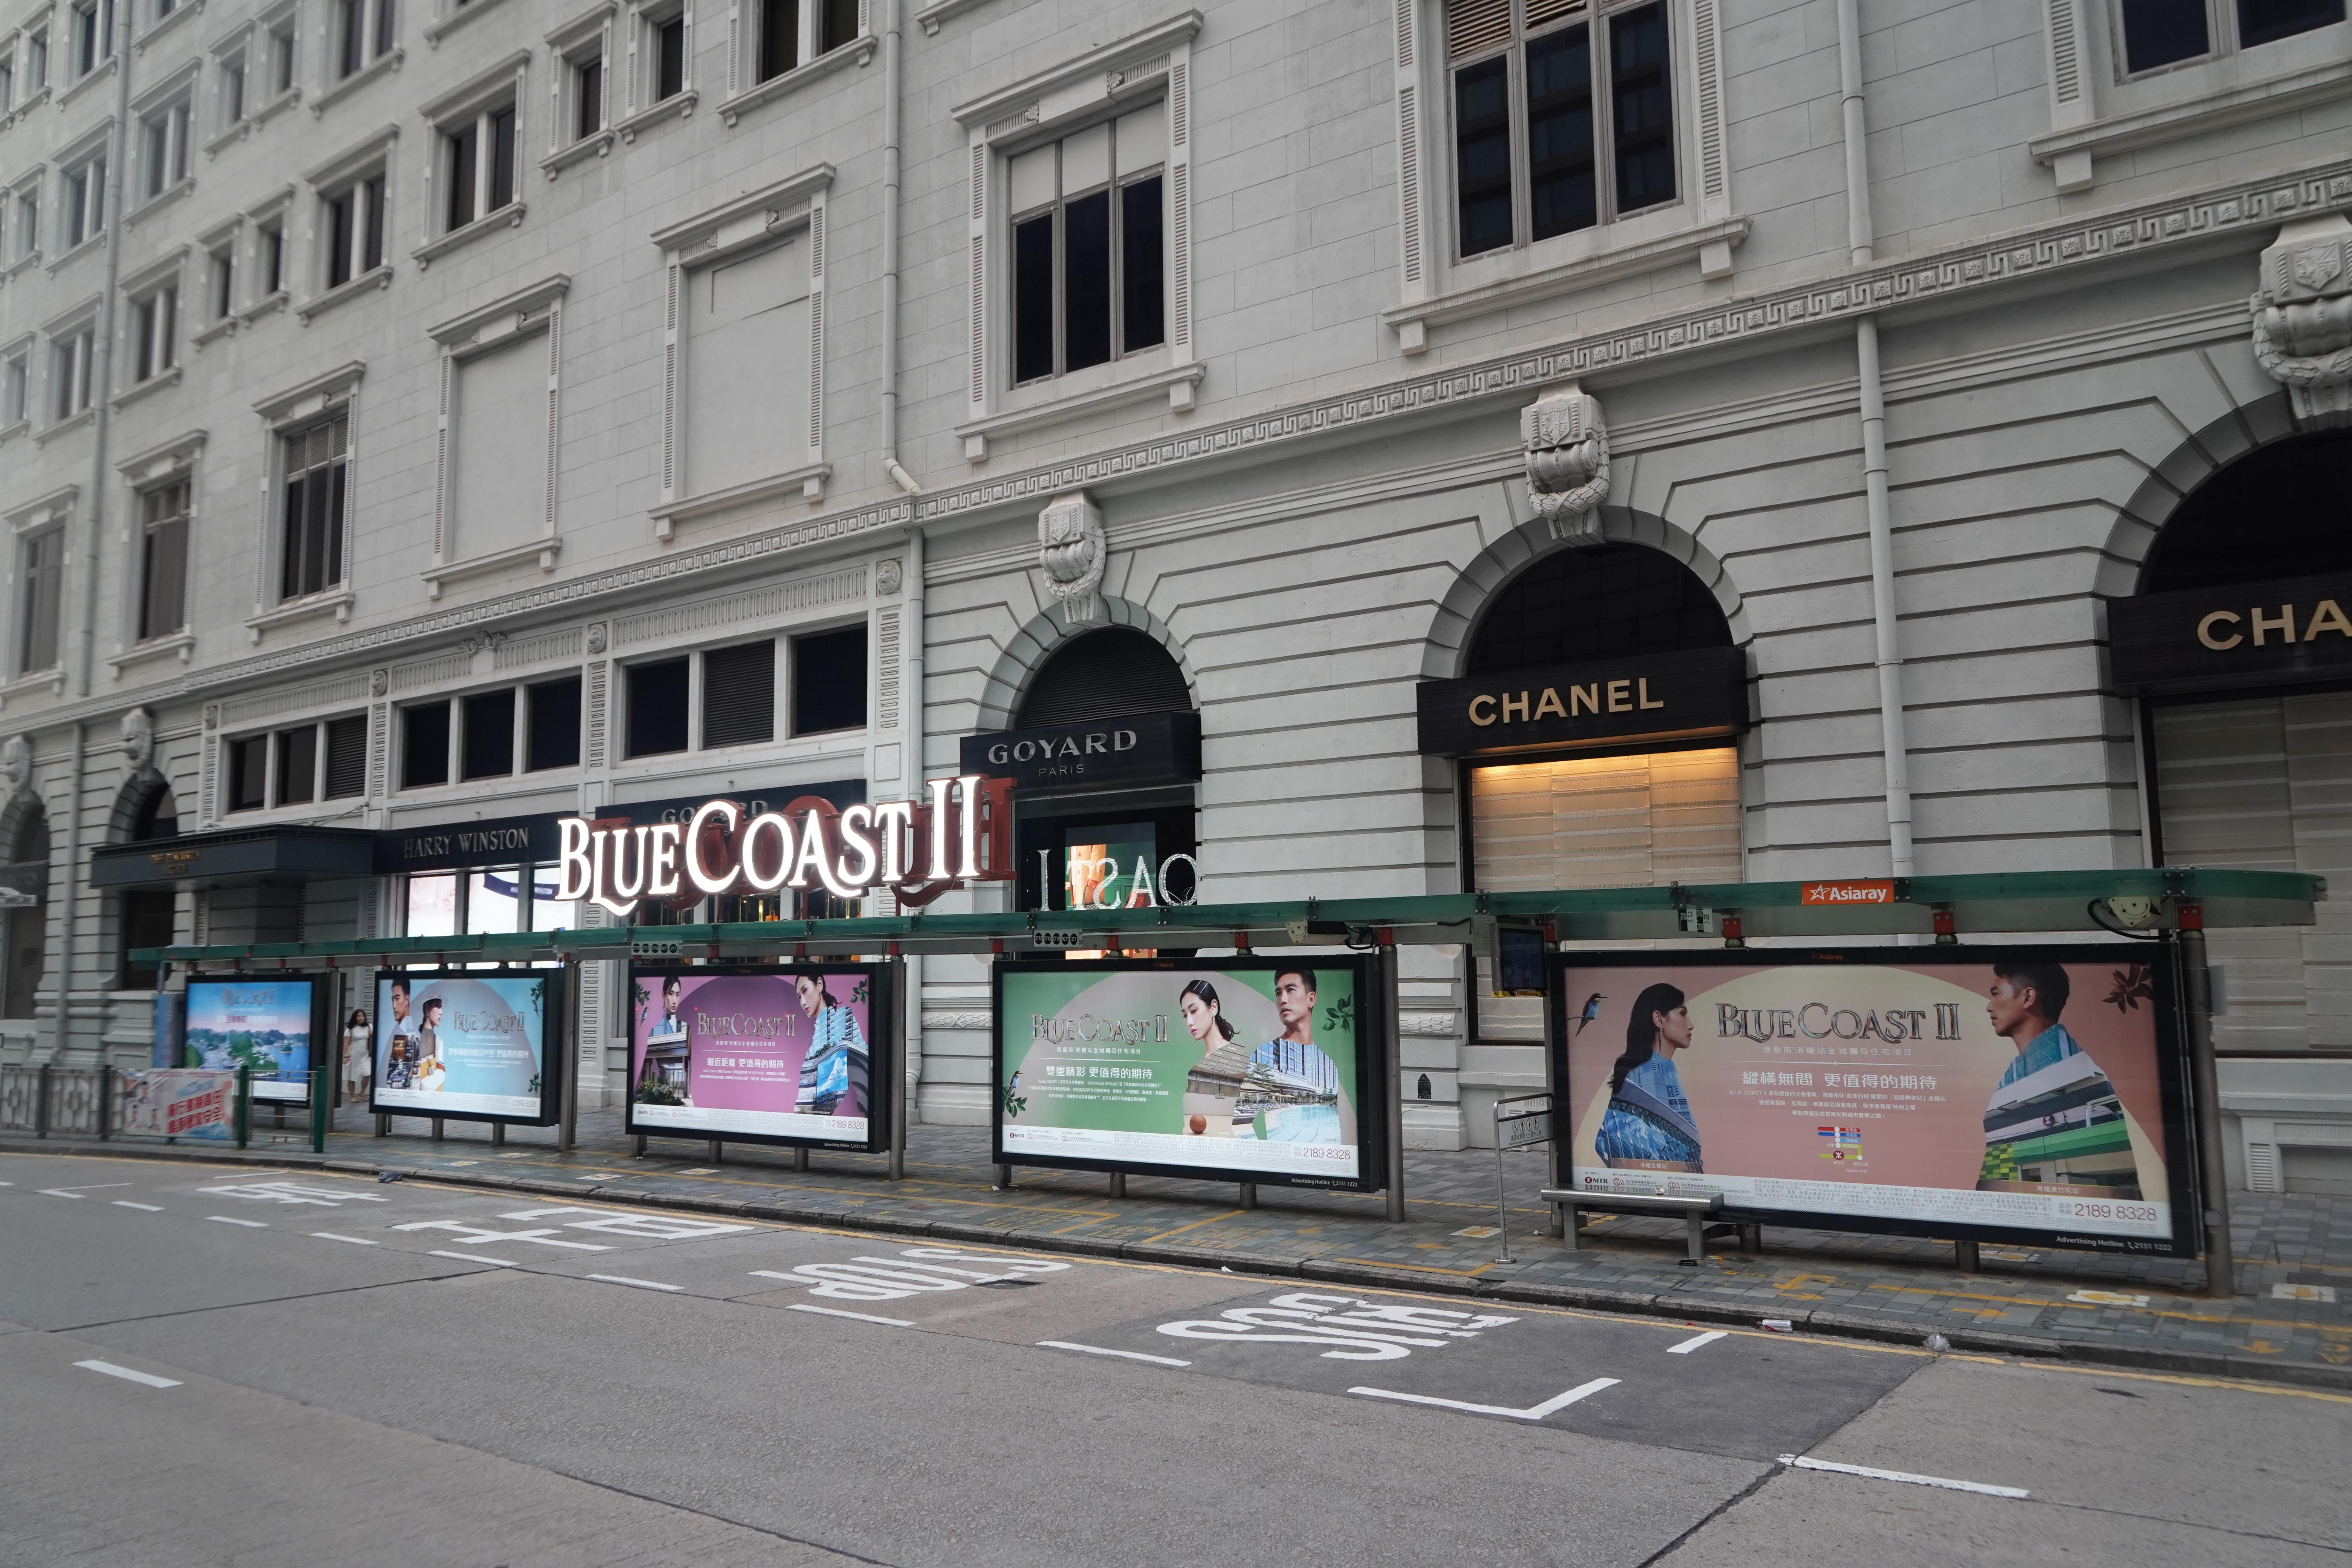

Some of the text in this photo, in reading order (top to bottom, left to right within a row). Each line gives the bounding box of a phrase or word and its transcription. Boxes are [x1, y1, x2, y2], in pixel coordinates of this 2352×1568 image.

[1469, 678, 1664, 726] CHANEL
[988, 730, 1136, 764] GOYARD
[1039, 764, 1084, 777] PARIS
[661, 800, 768, 824] GORD
[926, 776, 980, 879] II
[404, 828, 529, 858] HARRY WINSTON
[1829, 886, 1887, 902] Asiaray
[786, 1013, 796, 1037] II
[1154, 1014, 1170, 1042] II
[1933, 1003, 1962, 1040] II
[739, 1058, 784, 1069] 更值得的期待
[1046, 1065, 1153, 1080] 雙重精彩 更值得的期待
[1742, 1071, 1937, 1090] 縱橫無間 更值得的期待
[832, 1120, 846, 1128] 2189
[848, 1121, 864, 1129] 8328
[1303, 1147, 1350, 1160] 2189 8328
[2075, 1203, 2157, 1221] 2189 8328
[2056, 1236, 2096, 1246] Advertising
[2097, 1240, 2124, 1248] Hotline
[748, 1248, 1072, 1301] STOP
[1156, 1292, 1522, 1361] BUS
